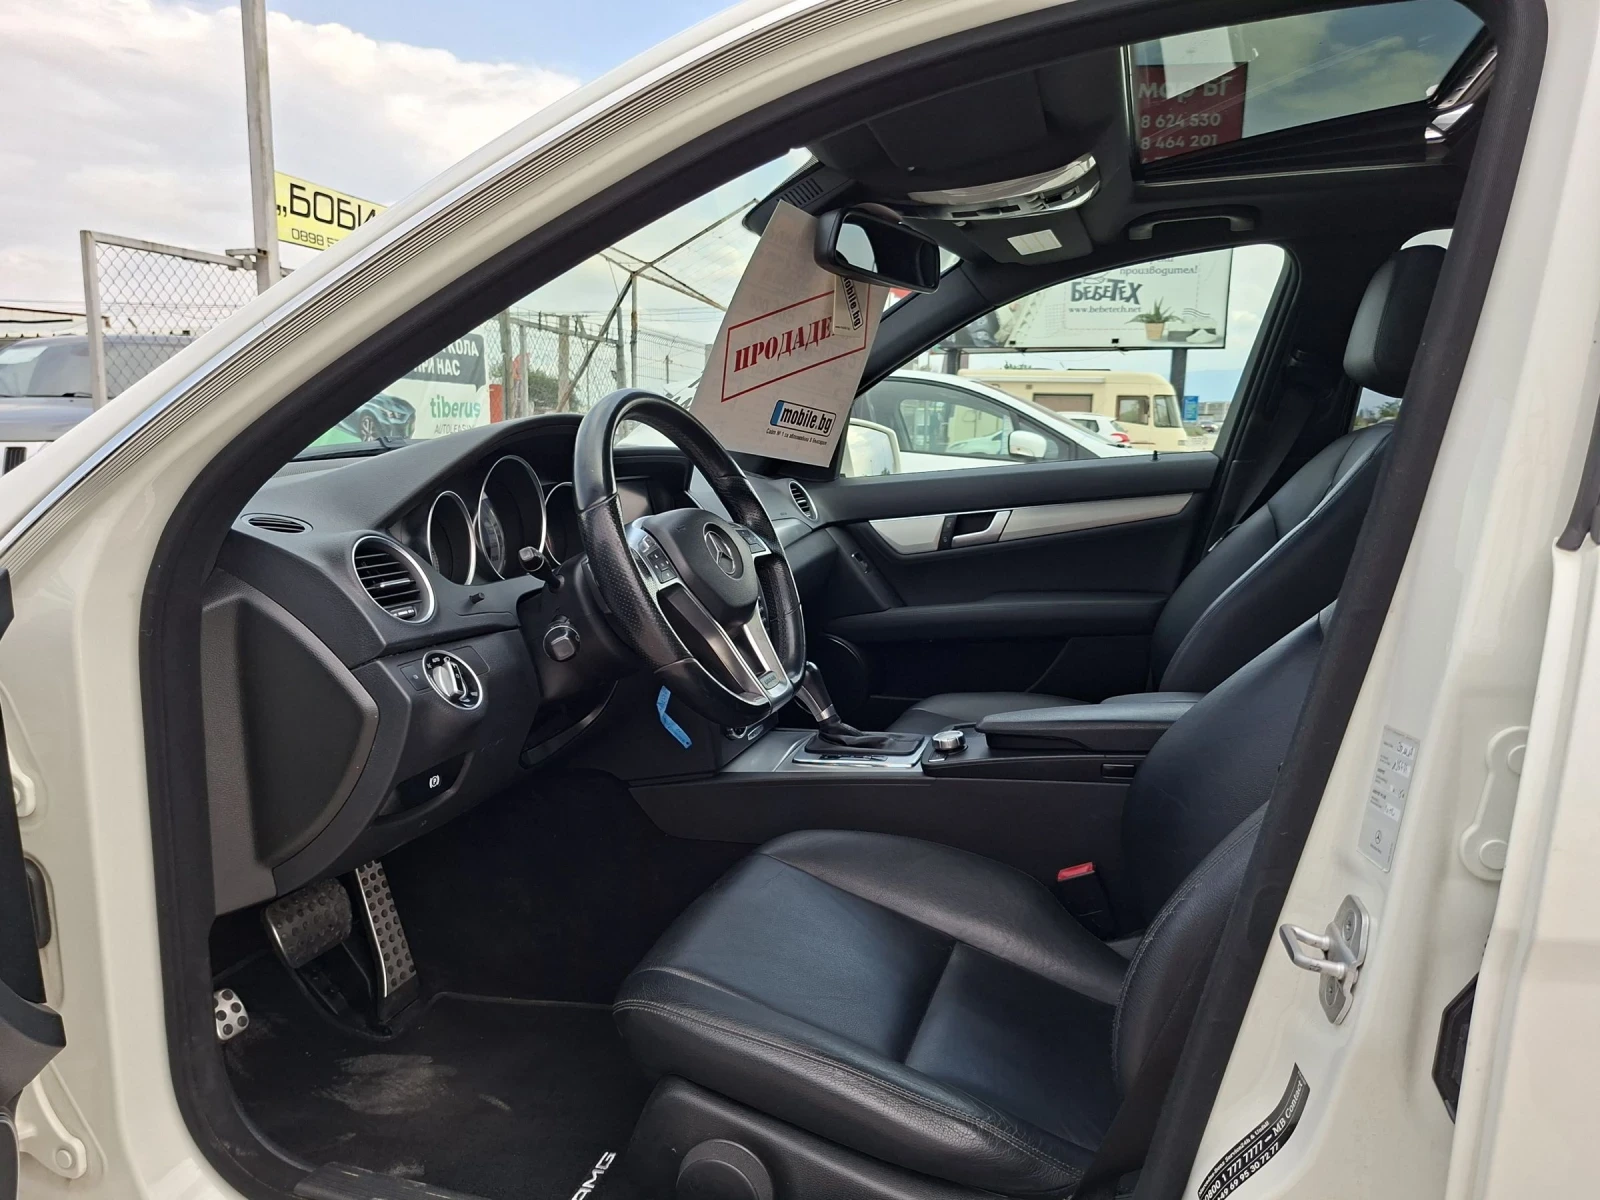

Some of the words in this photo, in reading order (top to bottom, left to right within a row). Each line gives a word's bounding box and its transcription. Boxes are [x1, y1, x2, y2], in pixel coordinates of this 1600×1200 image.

[1155, 114, 1185, 128] 624
[1189, 113, 1221, 127] 530
[1155, 136, 1185, 149] 464
[1189, 134, 1218, 147] 201
[291, 228, 324, 246] 0898
[1120, 265, 1198, 276] производител!
[1068, 305, 1141, 313] www.bebetech.net
[734, 316, 835, 372] ПРОДАДЕ
[436, 358, 460, 376] НАС
[430, 394, 480, 418] tiberus
[780, 407, 833, 434] mobile.bg
[1222, 1174, 1226, 1182] 1
[1227, 1159, 1242, 1177] 777
[1243, 1140, 1262, 1163] 7777
[1272, 1117, 1286, 1136] MB
[1285, 1080, 1303, 1119] Contact
[570, 1151, 616, 1200] AMG
[1229, 1179, 1239, 1190] 69
[1240, 1170, 1249, 1181] 95
[1250, 1161, 1260, 1172] 30
[1260, 1152, 1271, 1164] 72
[1270, 1142, 1279, 1155] 77
